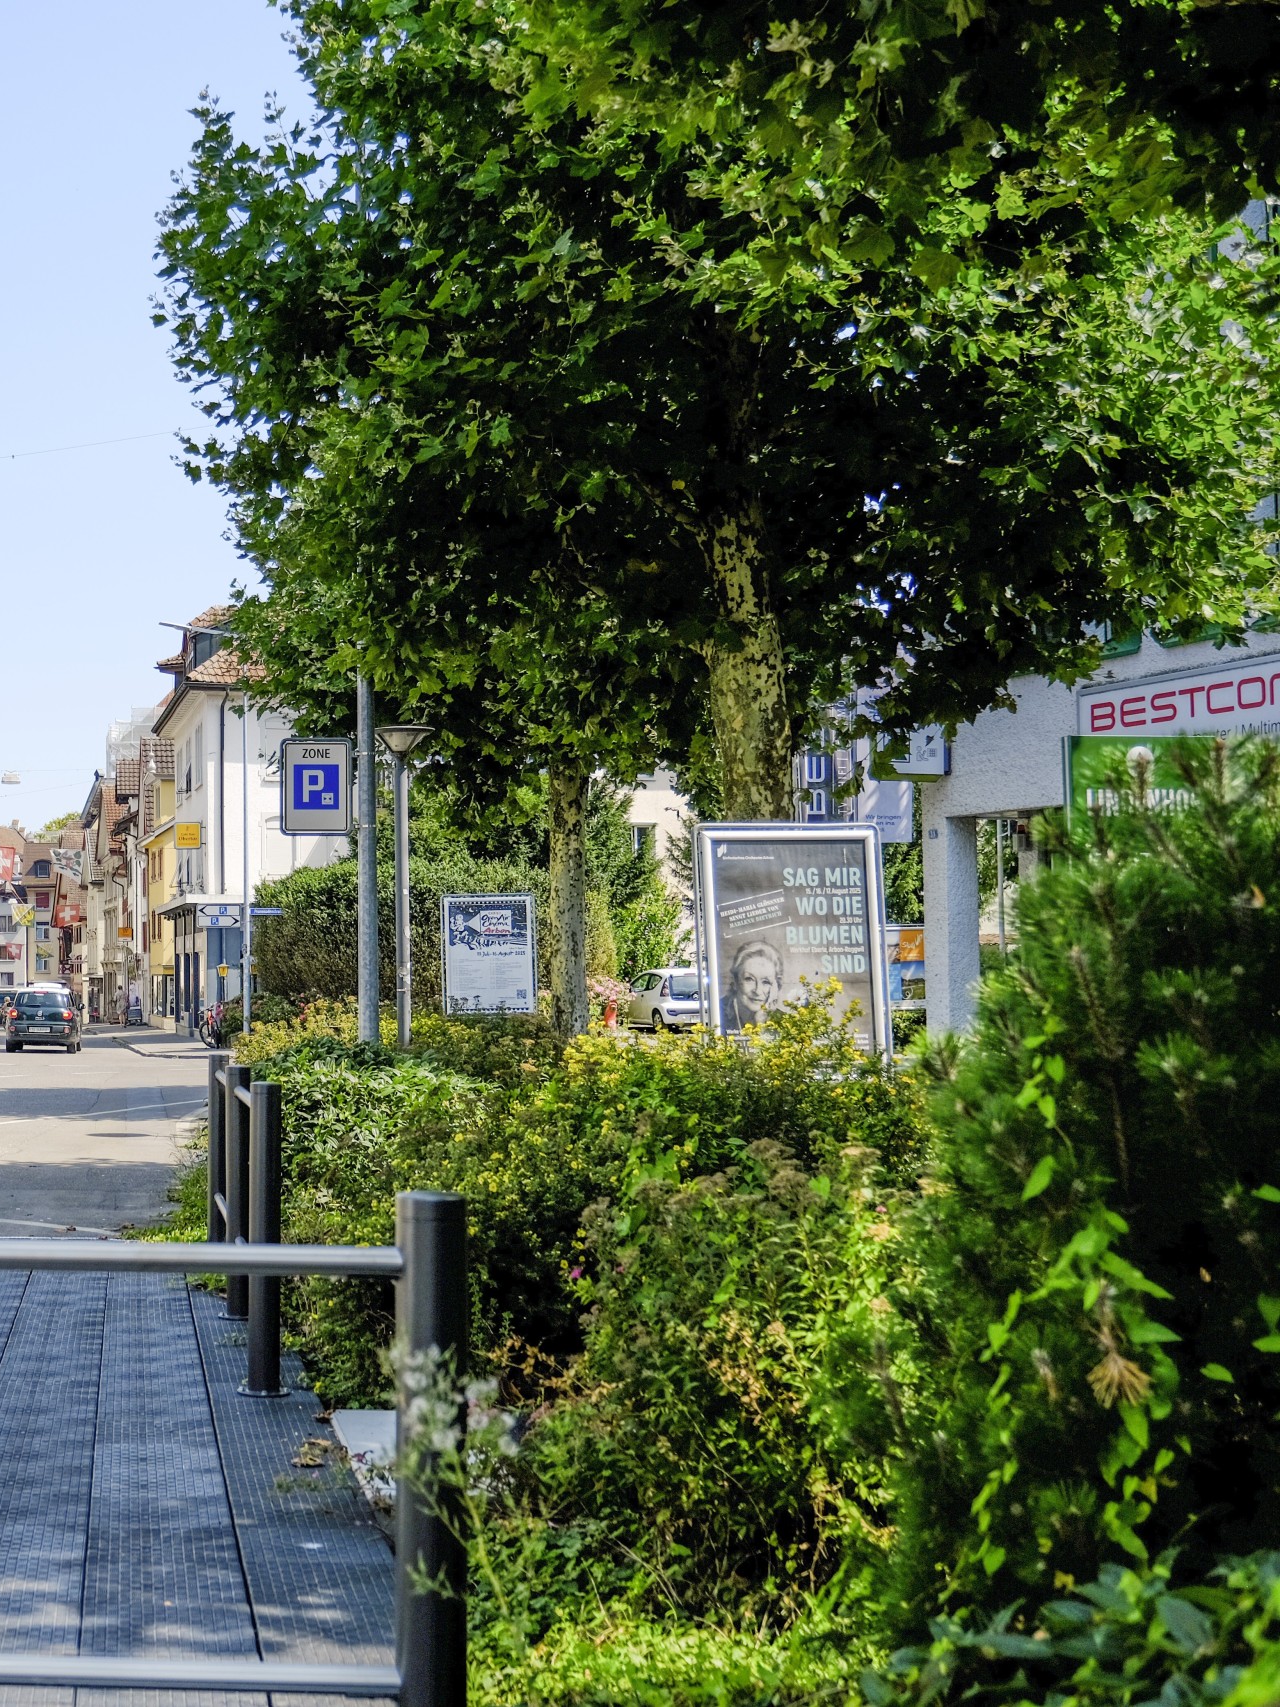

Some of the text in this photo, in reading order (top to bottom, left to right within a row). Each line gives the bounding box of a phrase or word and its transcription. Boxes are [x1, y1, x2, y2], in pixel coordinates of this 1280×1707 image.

[302, 749, 331, 759] ZONE
[302, 769, 325, 803] P
[783, 867, 862, 887] SAG MIR
[795, 896, 862, 916] WO DIE
[785, 925, 864, 945] BLUMEN
[821, 954, 865, 973] SIND
